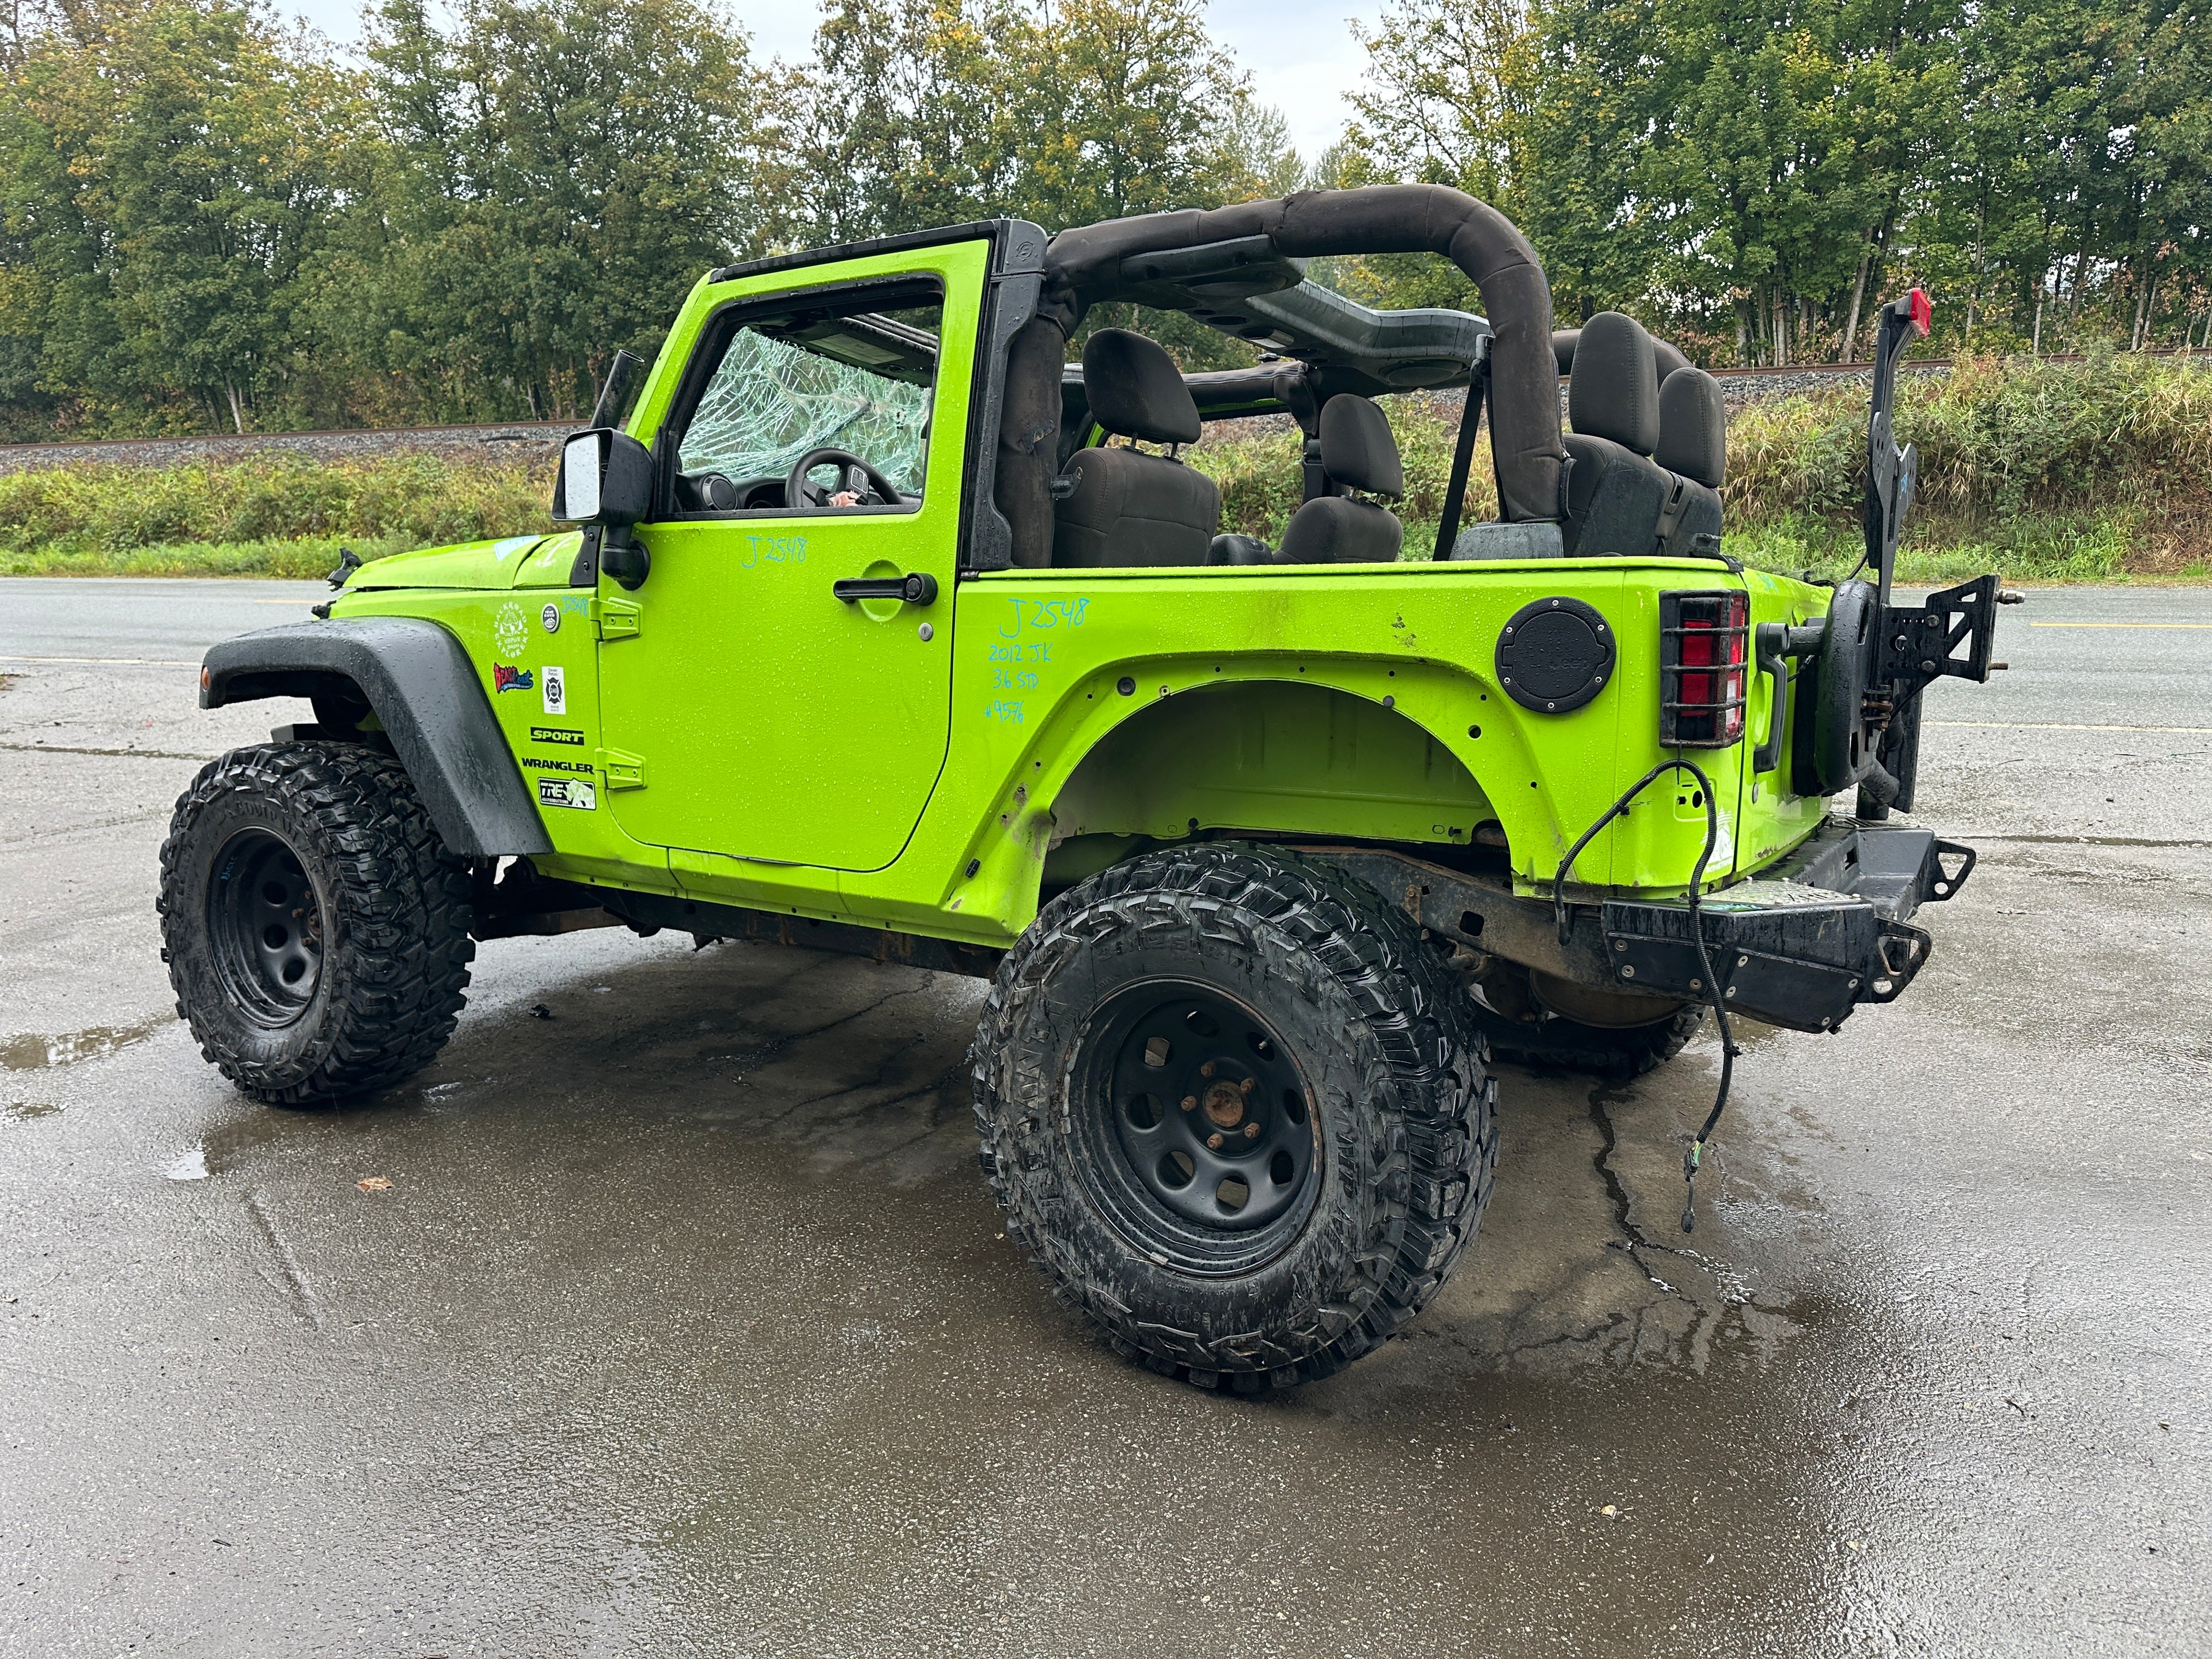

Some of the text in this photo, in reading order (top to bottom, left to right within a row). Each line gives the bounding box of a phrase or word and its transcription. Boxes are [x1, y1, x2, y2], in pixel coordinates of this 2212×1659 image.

[988, 642, 1054, 663] 2012 JK
[1016, 671, 1039, 690] STD
[532, 729, 584, 743] SPORT
[521, 757, 594, 775] WRANGLER
